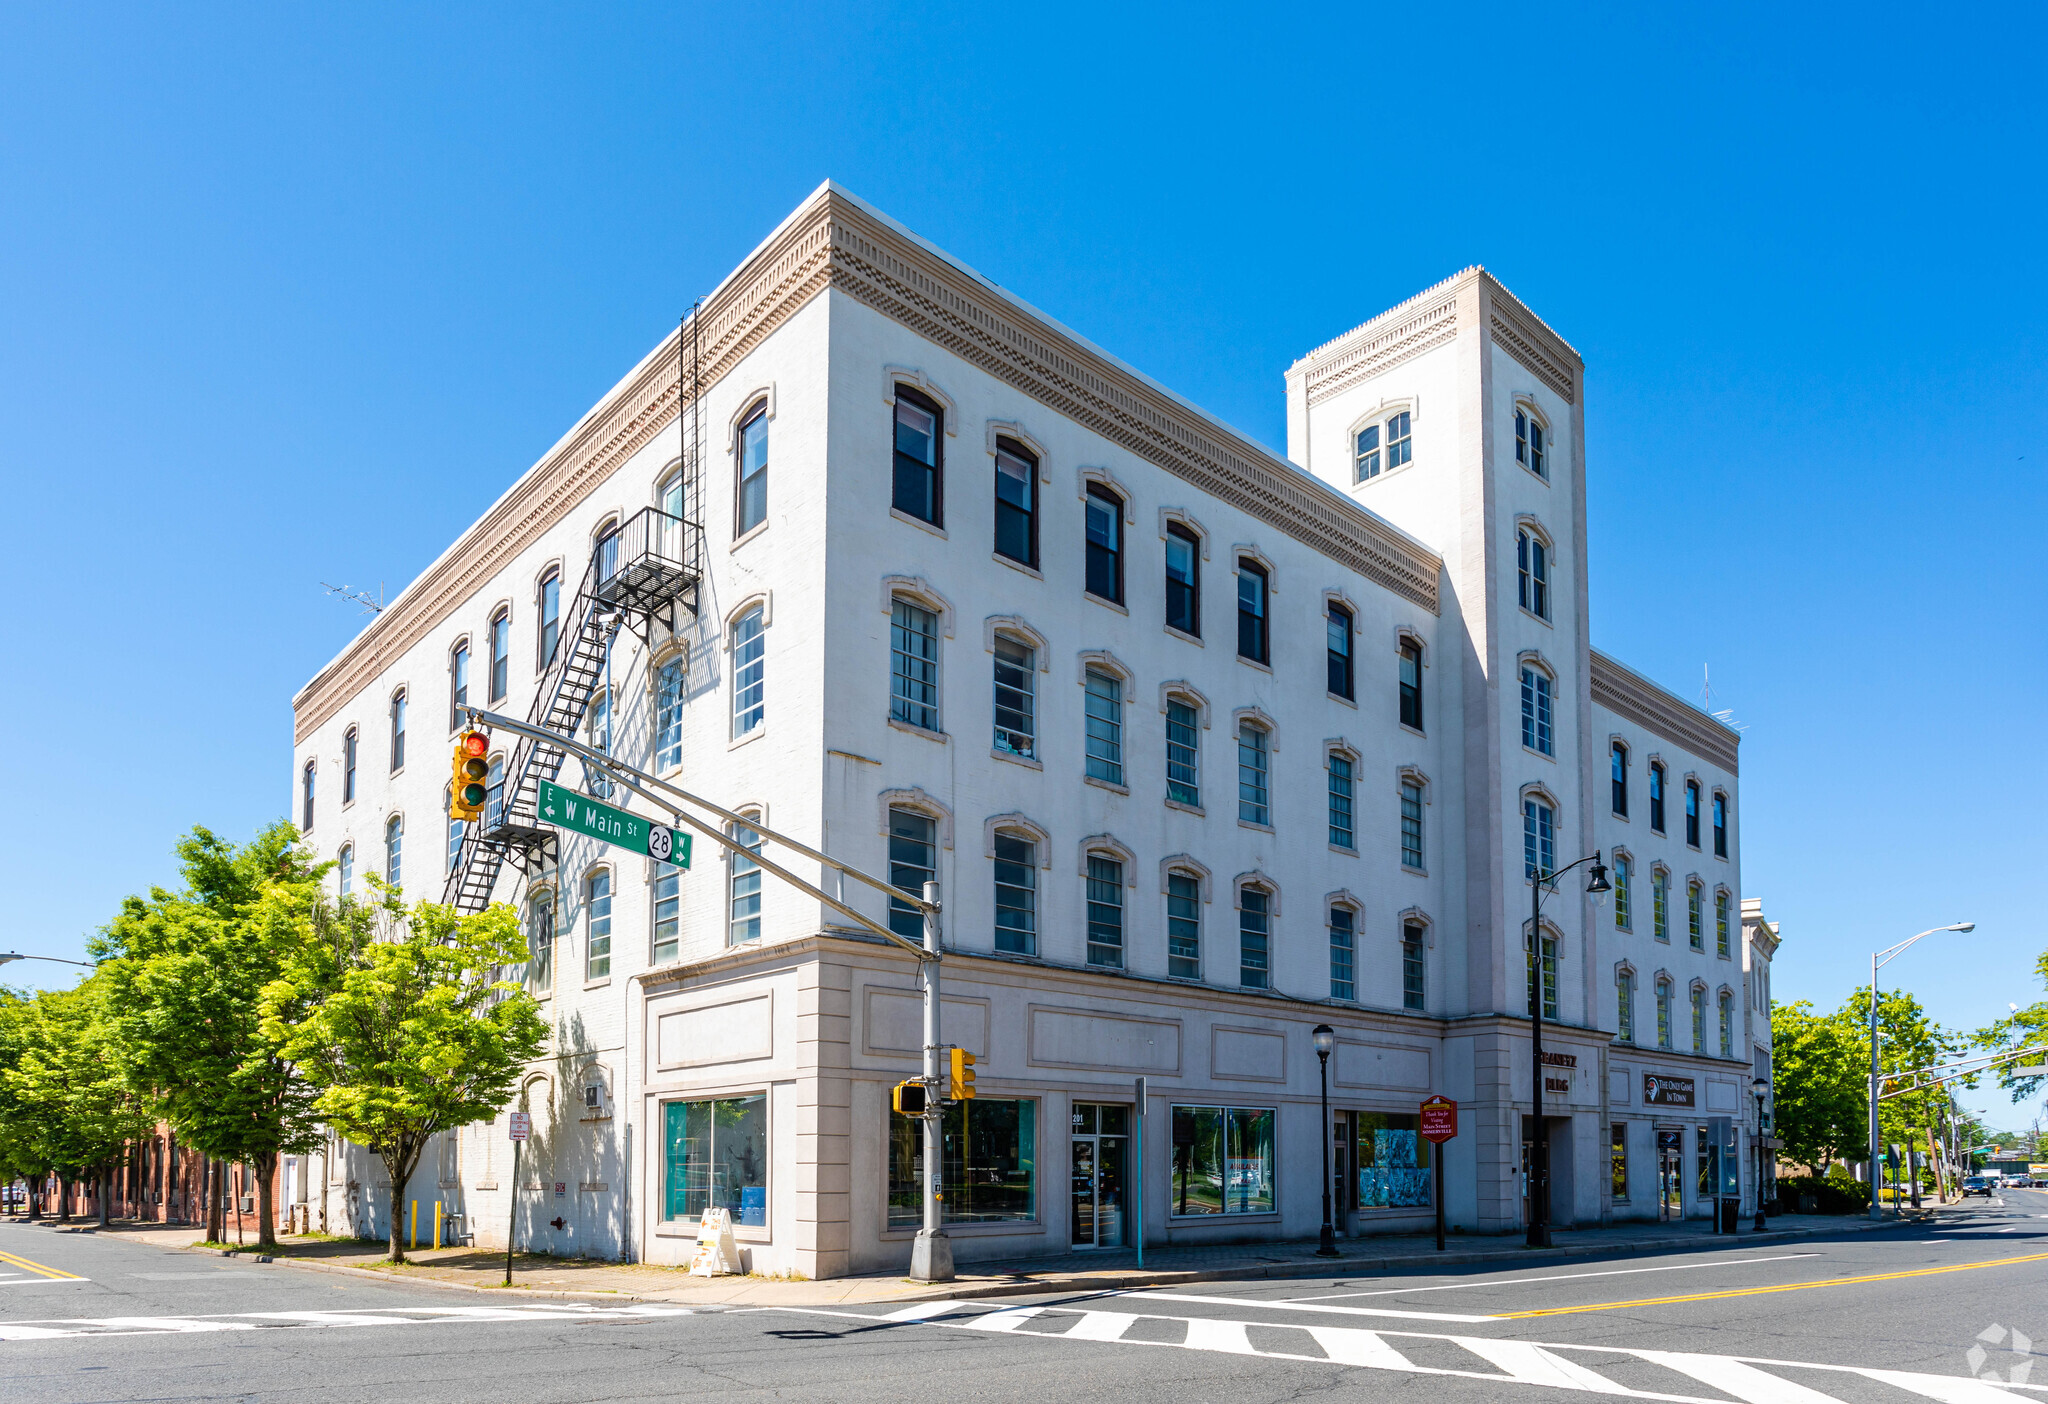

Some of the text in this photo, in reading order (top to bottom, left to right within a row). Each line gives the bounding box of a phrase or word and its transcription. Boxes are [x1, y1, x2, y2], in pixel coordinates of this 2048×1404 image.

[547, 788, 554, 801] E
[566, 799, 637, 837] W Main St
[651, 831, 669, 853] 28
[678, 836, 686, 848] W
[1658, 1079, 1693, 1092] THE ONLY GAME
[1666, 1092, 1687, 1102] IN TOWN
[1072, 1114, 1083, 1123] 201
